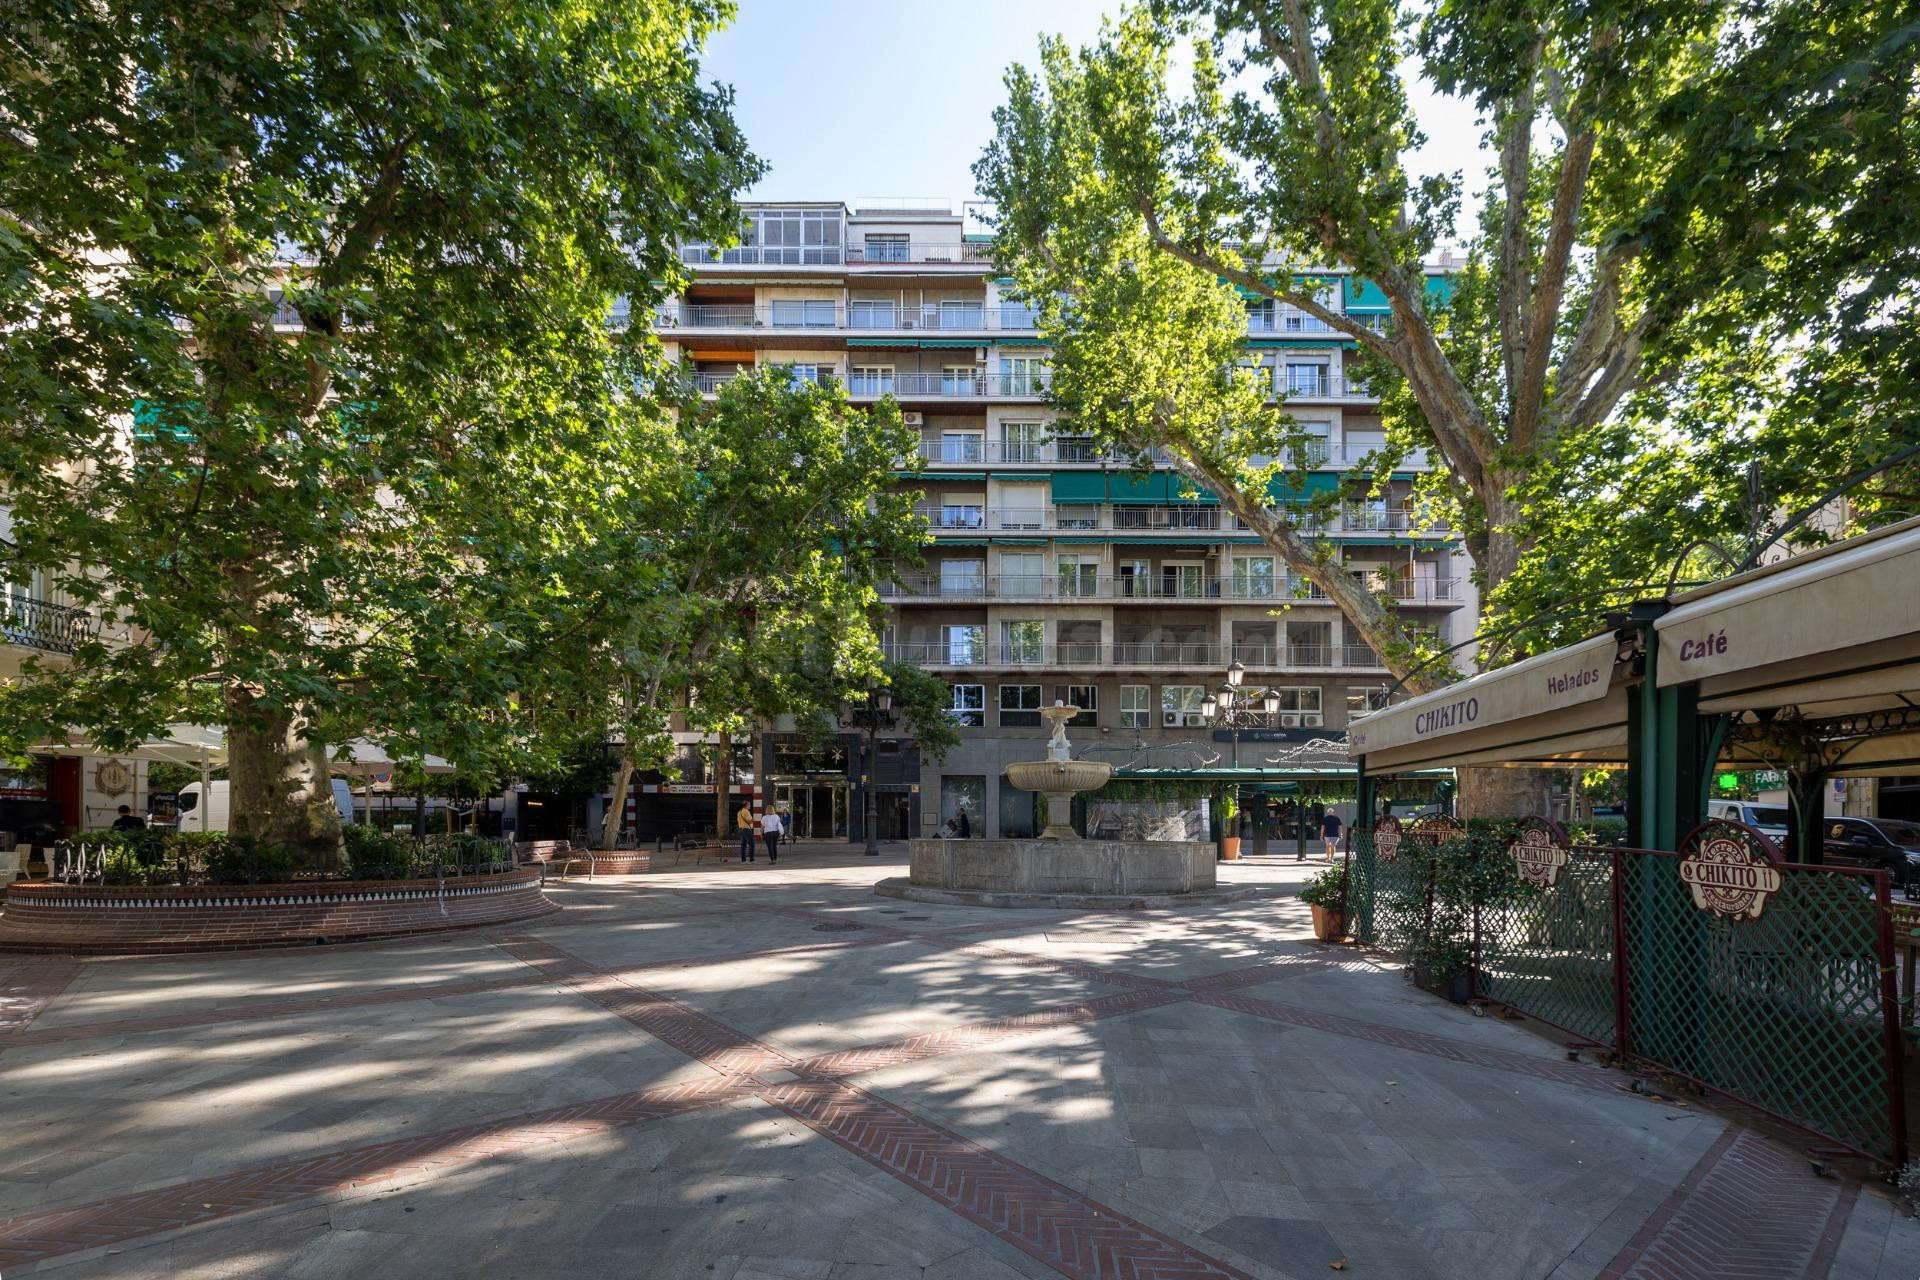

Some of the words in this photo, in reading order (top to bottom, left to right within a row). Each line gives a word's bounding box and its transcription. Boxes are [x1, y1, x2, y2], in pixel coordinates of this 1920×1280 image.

[1680, 629, 1728, 661] Café
[1547, 668, 1600, 695] Helados
[1415, 698, 1479, 734] CHIKITO
[1519, 846, 1553, 864] CHIKITO
[1707, 842, 1742, 861] terraza
[1695, 863, 1758, 888] CHIKITO
[1706, 890, 1751, 911] restaurante
